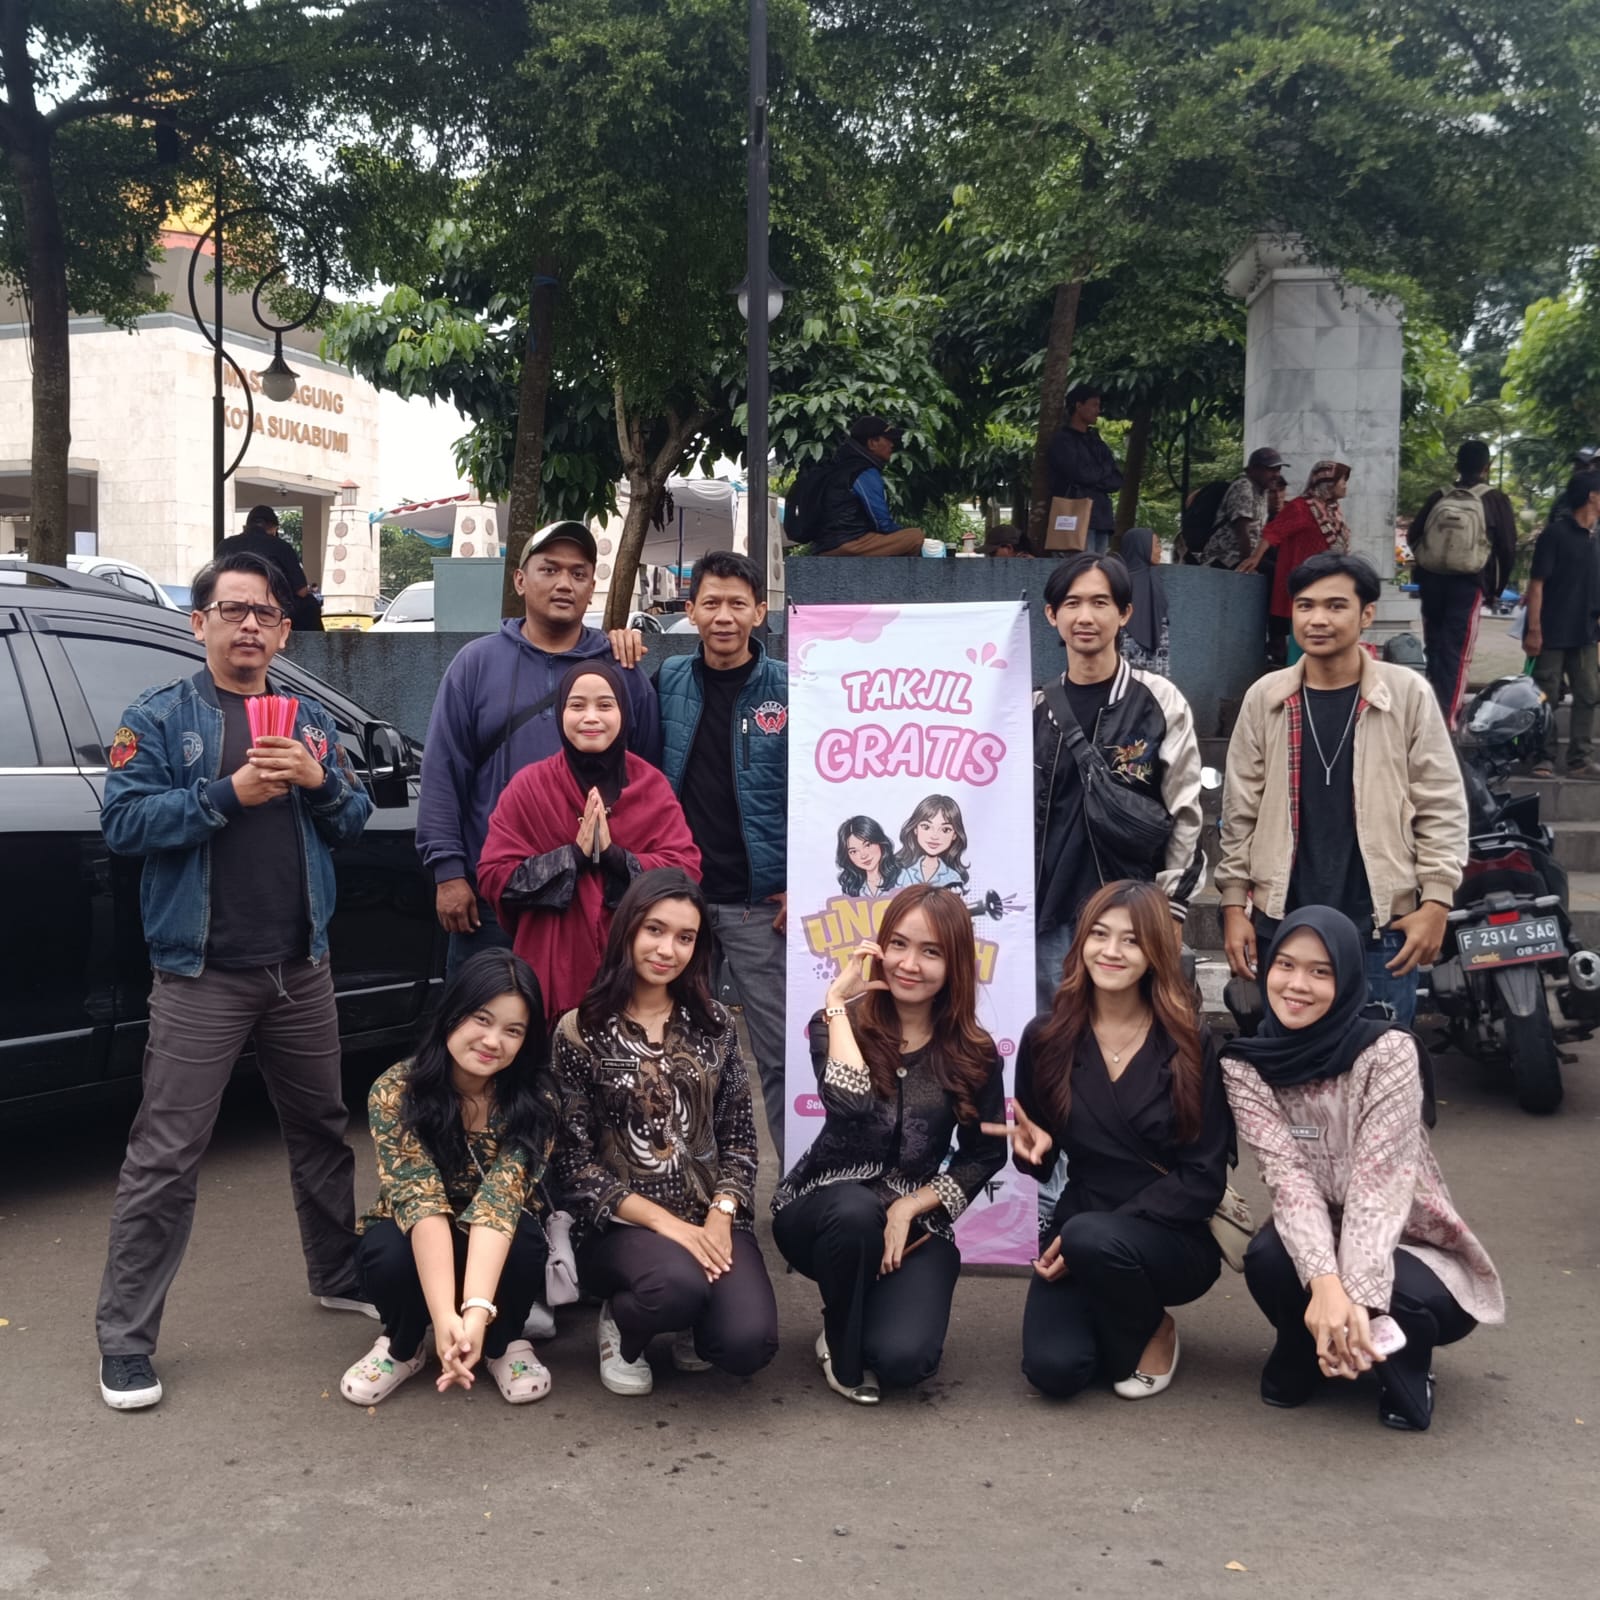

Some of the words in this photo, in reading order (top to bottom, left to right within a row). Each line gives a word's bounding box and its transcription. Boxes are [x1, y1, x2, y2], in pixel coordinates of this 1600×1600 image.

[267, 415, 348, 454] SUKABUMI
[841, 668, 972, 714] TAKJIL
[815, 722, 1006, 786] GRATIS
[1463, 934, 1473, 950] F
[1480, 928, 1518, 946] 2914
[1525, 923, 1556, 940] SAC
